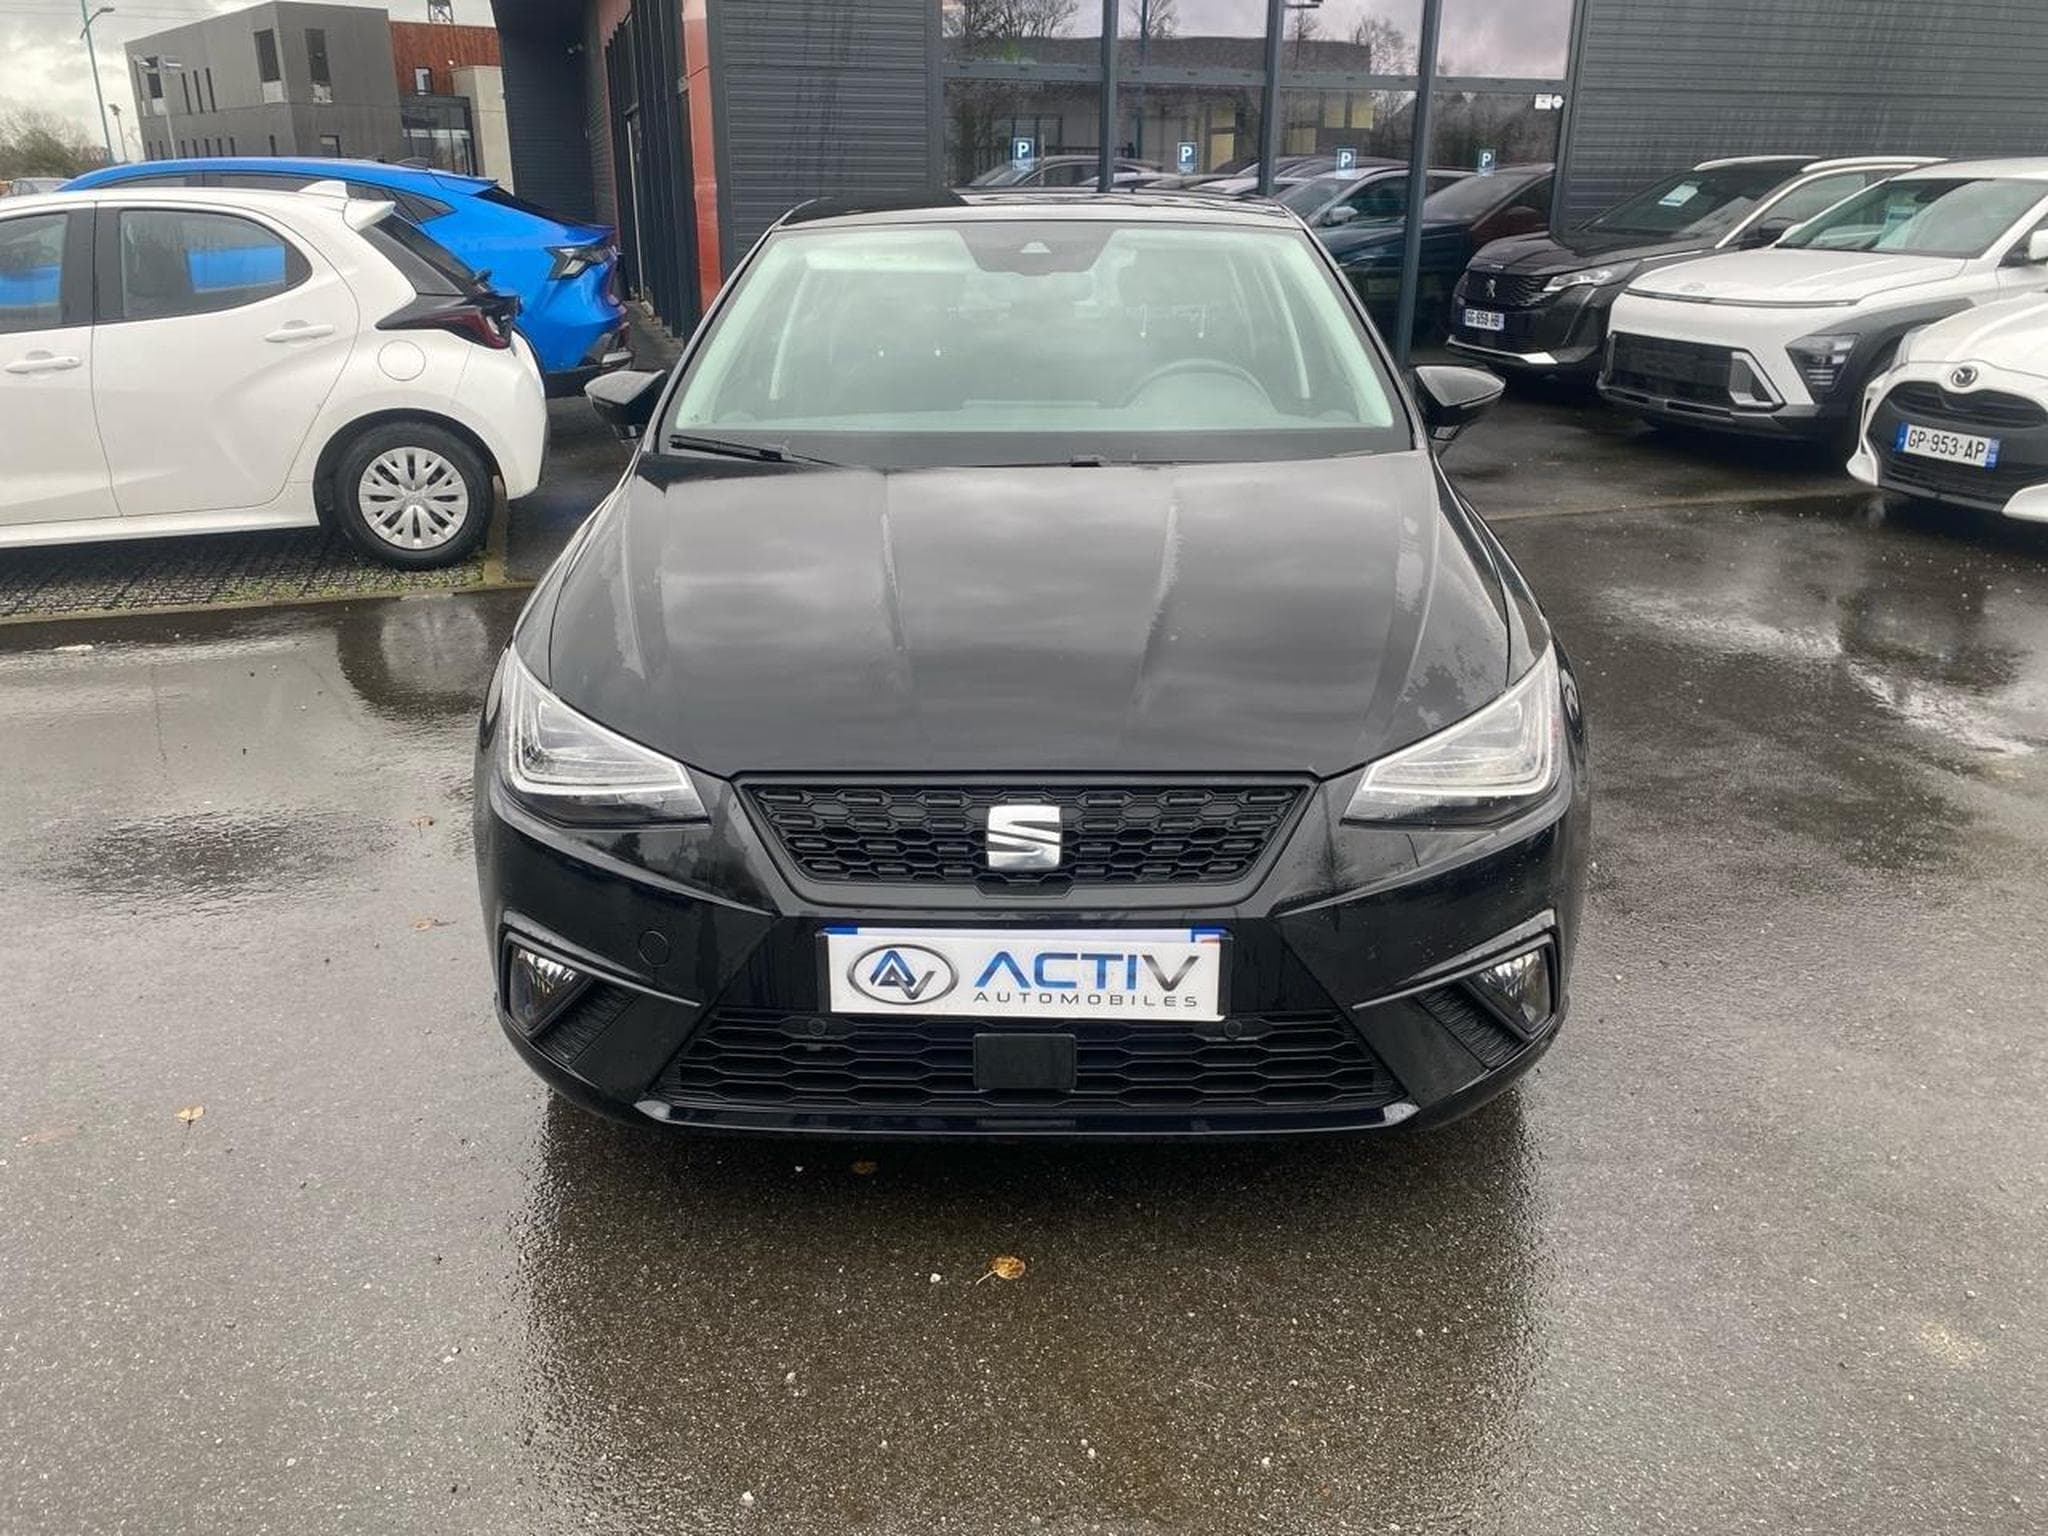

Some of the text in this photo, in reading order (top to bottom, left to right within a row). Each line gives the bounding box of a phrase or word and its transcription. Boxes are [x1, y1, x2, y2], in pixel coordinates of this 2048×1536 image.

[1017, 142, 1030, 159] P
[1180, 146, 1193, 163] P
[1340, 151, 1352, 168] P
[1482, 152, 1492, 168] P
[1908, 429, 1986, 460] GP-953-AP
[974, 951, 1200, 992] ACTIV
[974, 992, 1198, 1007] AUTOMOBILES
